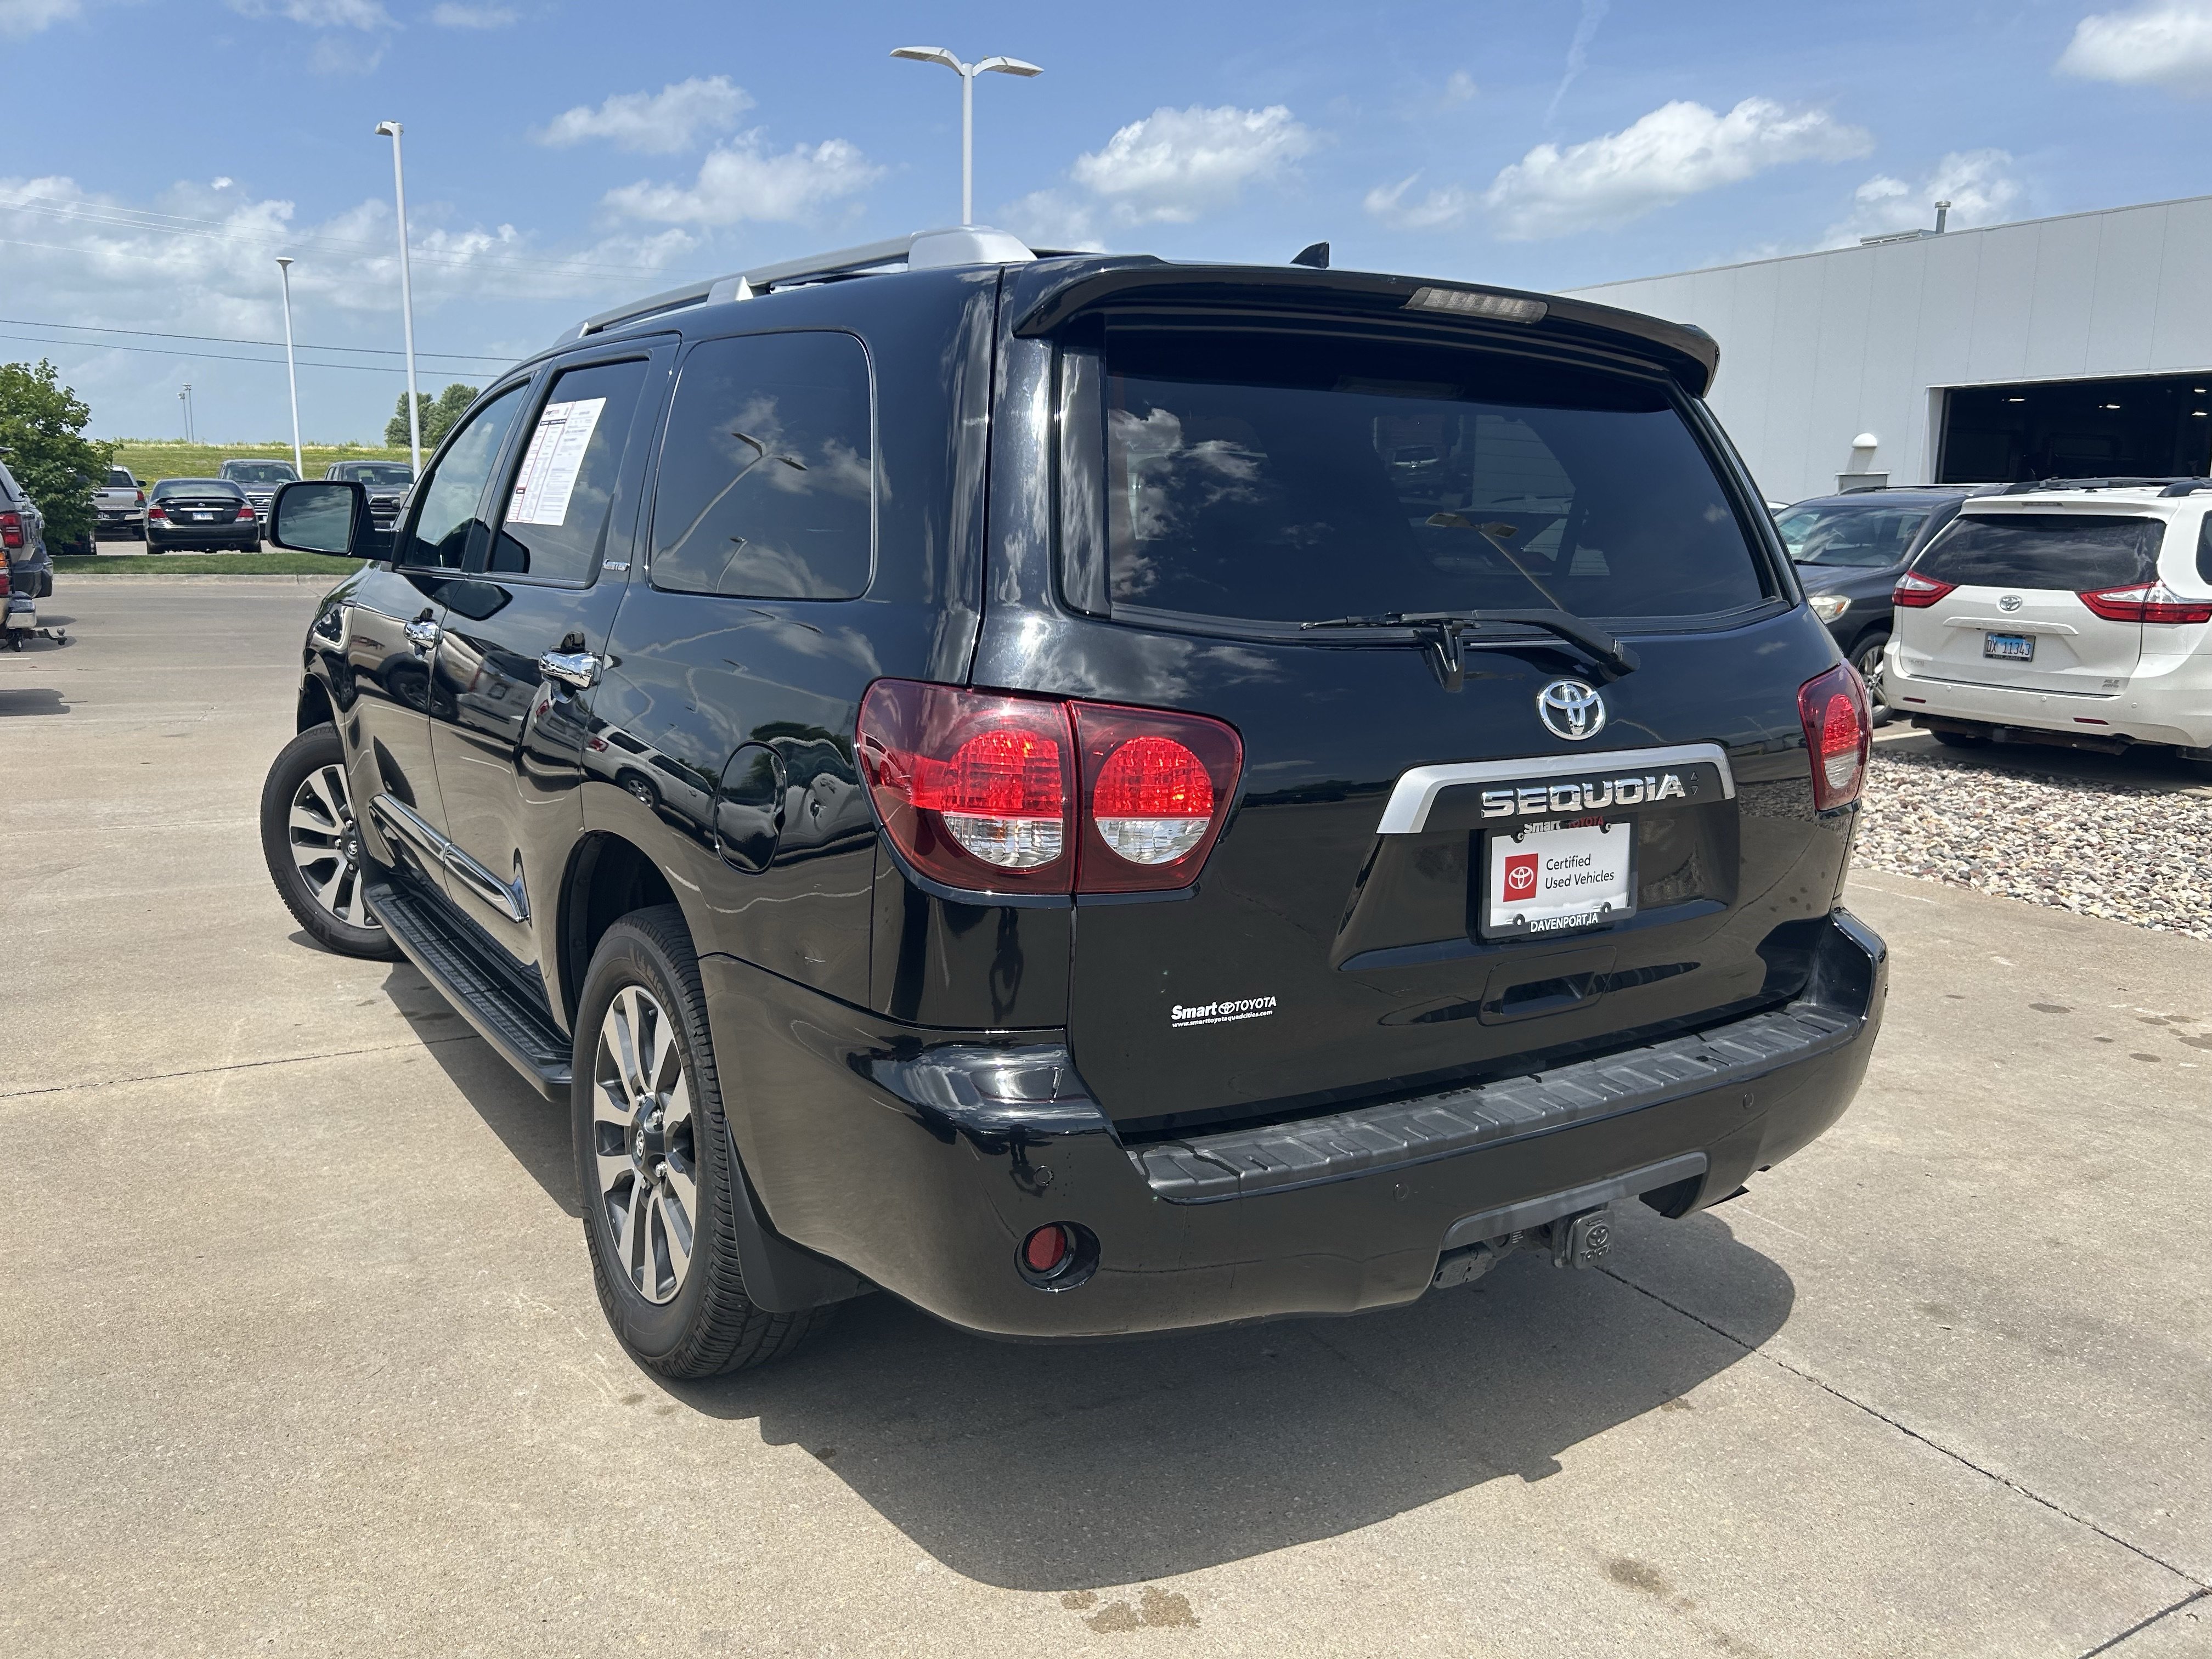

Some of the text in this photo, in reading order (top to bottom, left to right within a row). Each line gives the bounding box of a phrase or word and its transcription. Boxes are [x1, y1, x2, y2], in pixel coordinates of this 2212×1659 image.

[1986, 640, 2031, 656] DX 11343
[1481, 774, 1686, 819] SEQUOIA
[1523, 816, 1604, 834] Smart TOYOTA
[1545, 853, 1592, 871] Certified
[1545, 869, 1615, 890] Used Vehicles
[646, 964, 685, 1051] MICHELIN
[1171, 996, 1277, 1020] Smart TOYOTA
[1171, 1009, 1273, 1028] www.smarttoyotaquadcities.com
[1579, 1243, 1612, 1262] TOYOTA
